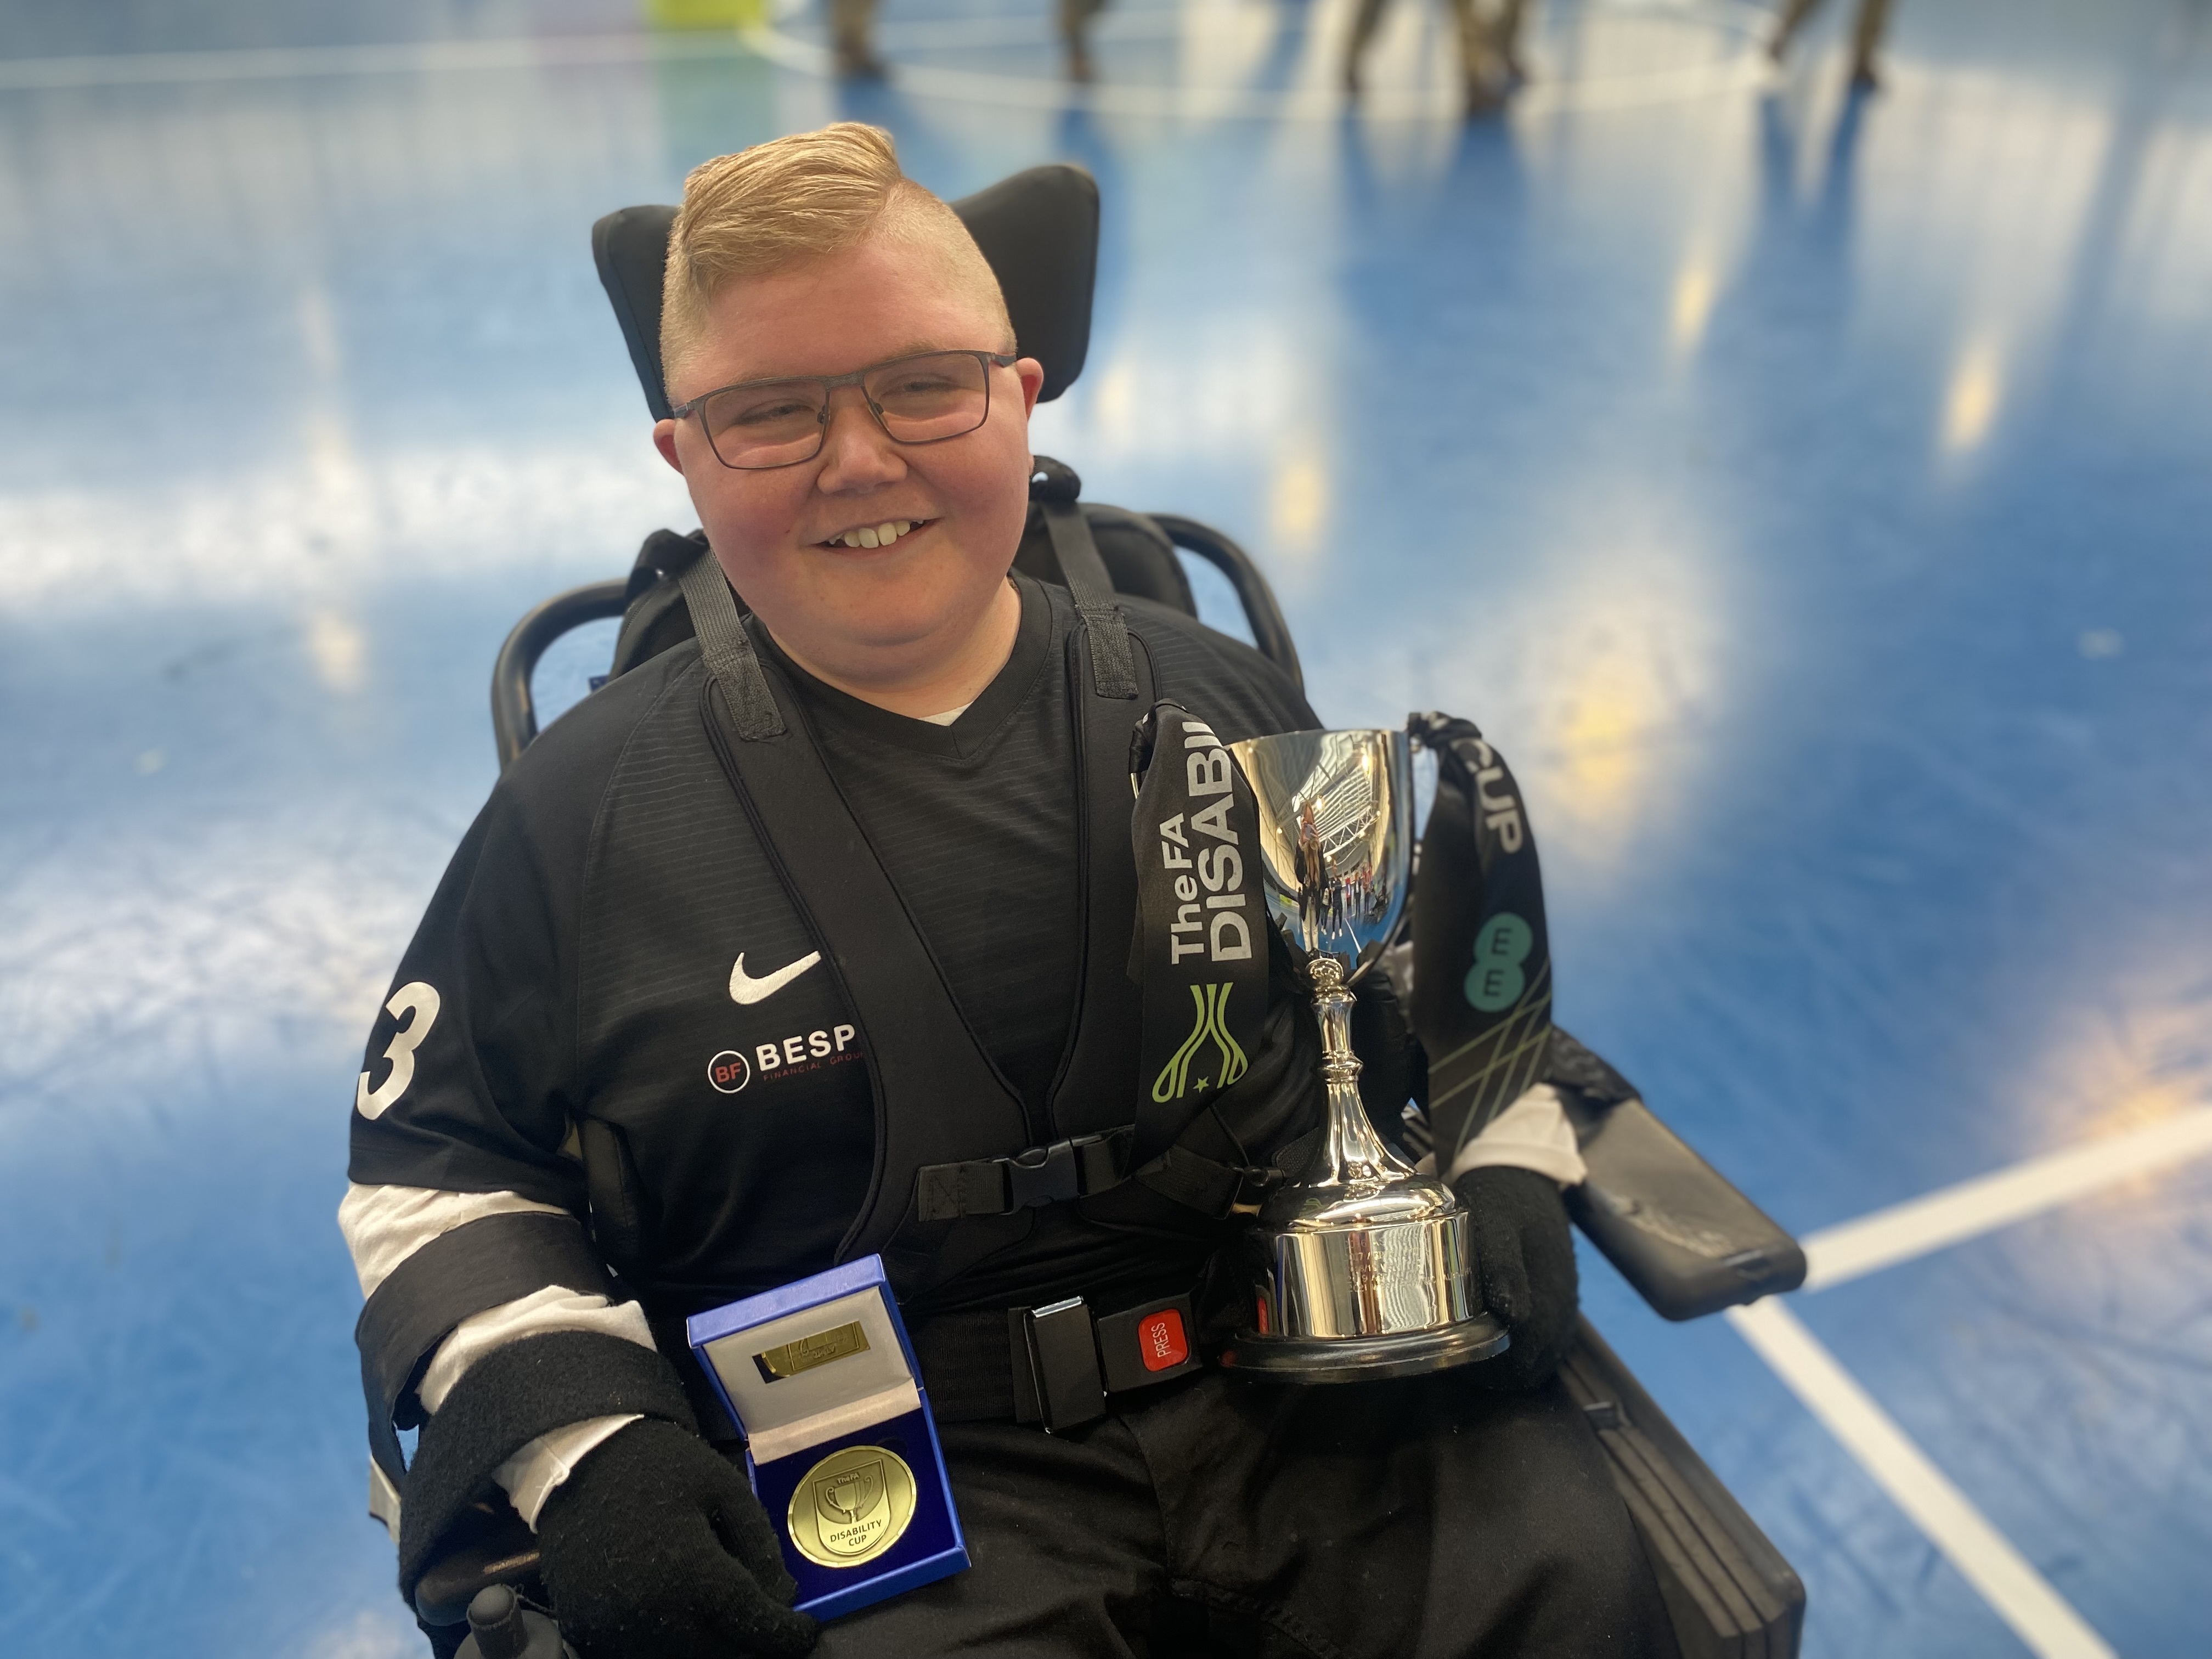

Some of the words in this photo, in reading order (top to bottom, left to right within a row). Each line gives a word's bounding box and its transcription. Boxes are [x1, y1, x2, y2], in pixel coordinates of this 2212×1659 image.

[357, 981, 441, 1121] 3
[755, 1024, 855, 1071] BESP
[715, 1062, 741, 1084] BF
[763, 1062, 821, 1082] FINANCIAL
[1150, 1322, 1172, 1358] PRESS
[830, 1519, 882, 1543] DISABILITY
[848, 1534, 867, 1547] CUP
